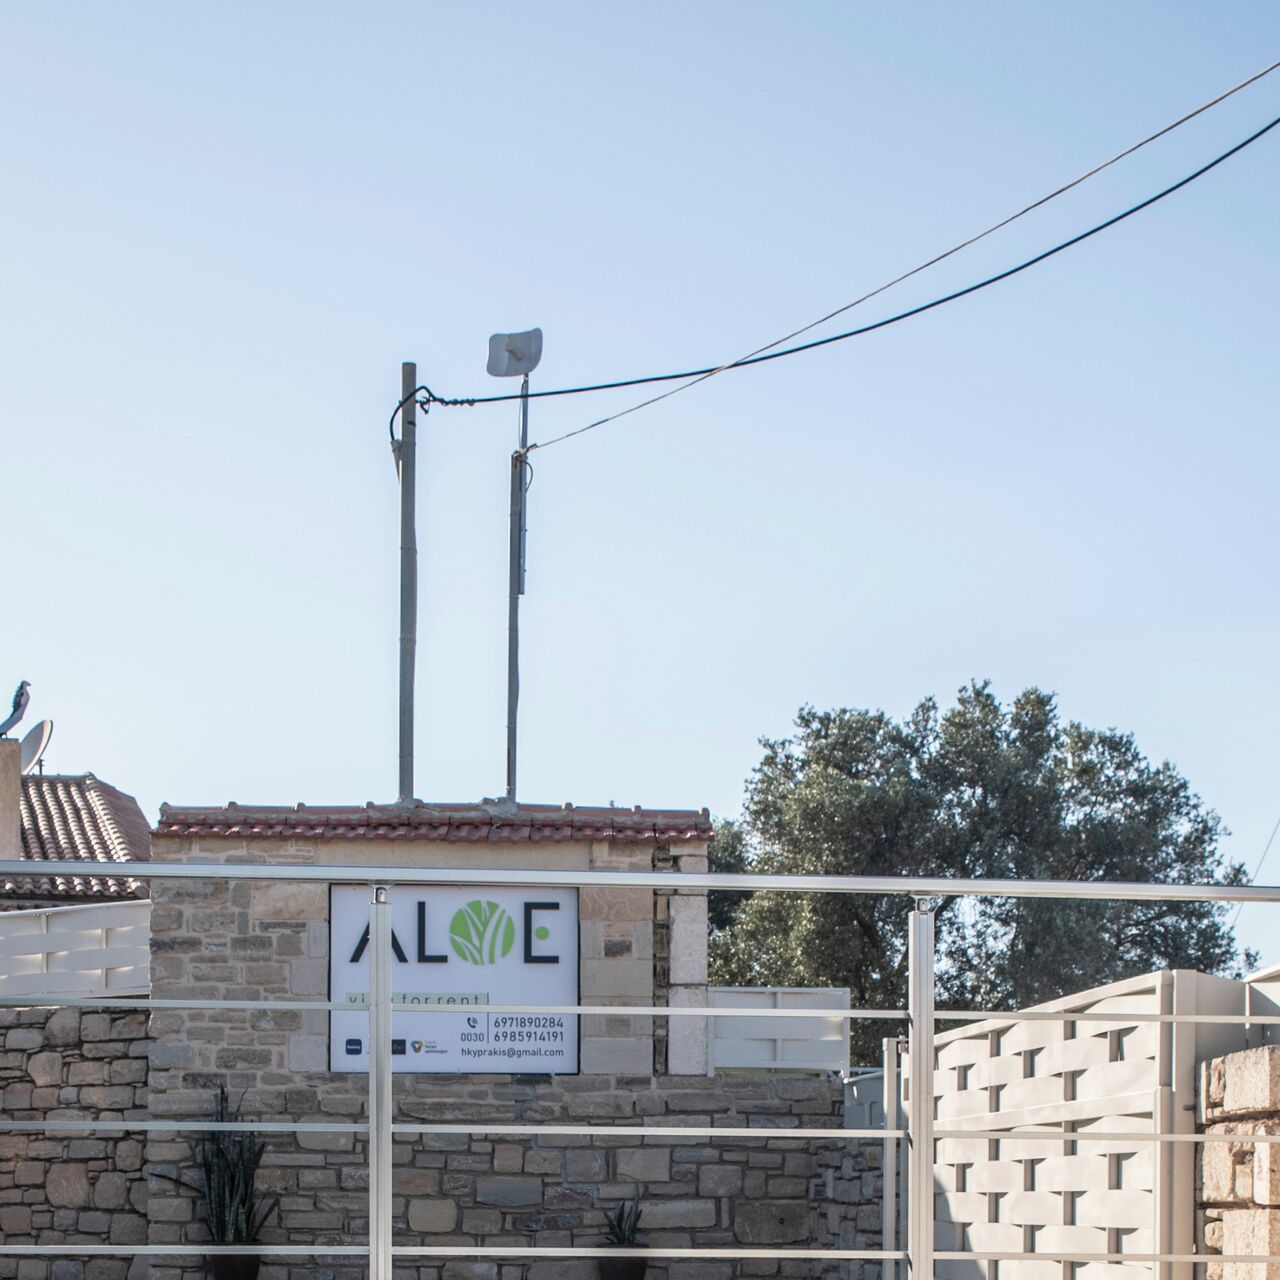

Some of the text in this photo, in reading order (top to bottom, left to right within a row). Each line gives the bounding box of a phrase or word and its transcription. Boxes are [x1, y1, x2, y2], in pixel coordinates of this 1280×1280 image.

[402, 993, 430, 1004] for
[438, 993, 478, 1005] rent
[494, 1017, 563, 1028] 6971890284
[461, 1031, 564, 1042] 0030 6985914191
[461, 1047, 564, 1058] hkyprakis@gmail.com
